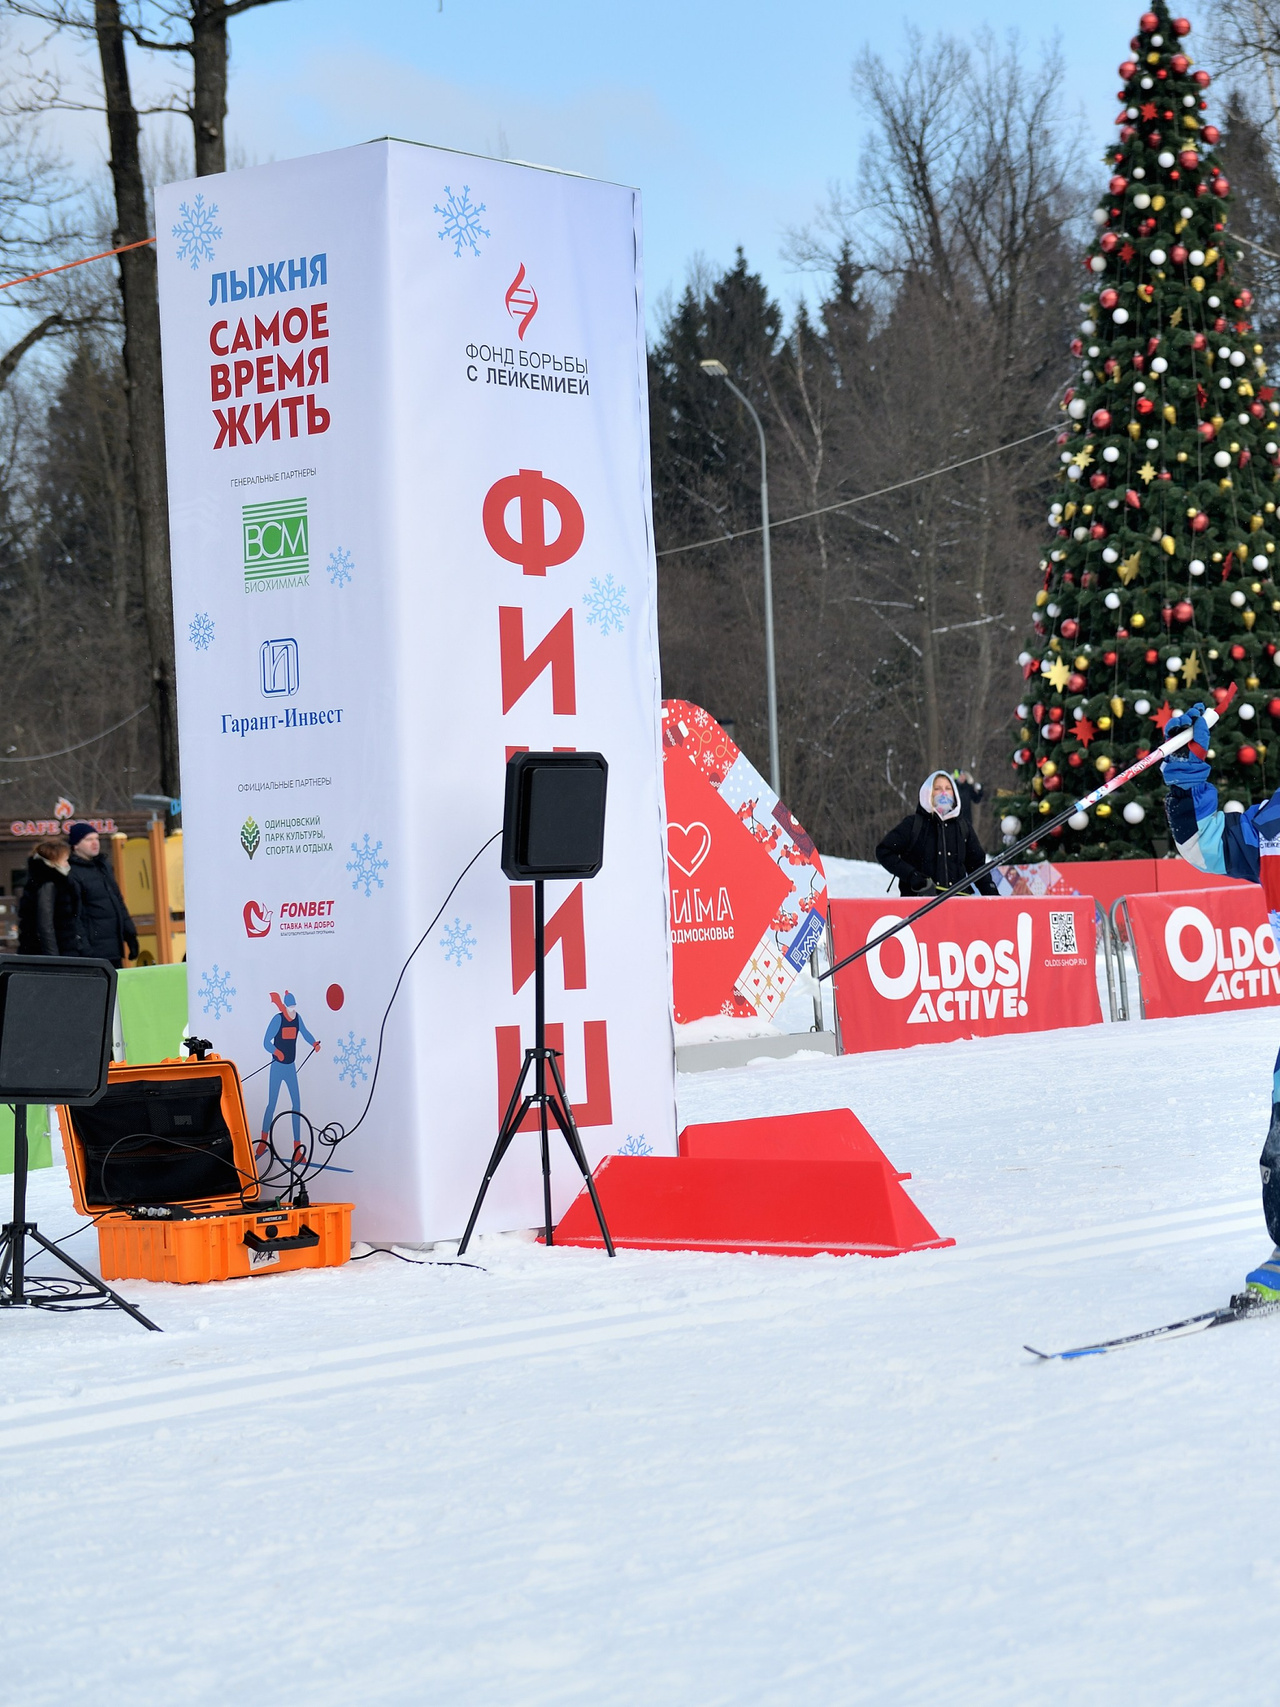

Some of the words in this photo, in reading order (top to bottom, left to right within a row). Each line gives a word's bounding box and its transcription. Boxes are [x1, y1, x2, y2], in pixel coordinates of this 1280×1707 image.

[208, 252, 328, 307] ЛЫЖНЯ
[209, 302, 330, 357] САМОЕ
[210, 345, 329, 403] ВРЕМЯ
[465, 343, 515, 367] ФОНД
[519, 350, 589, 375] БОРЬБЫ
[466, 364, 479, 383] С
[486, 366, 590, 396] ЛЕЙКЕМИЕЙ
[212, 393, 331, 450] ЖИТЬ
[230, 472, 280, 488] ГЕНЕРАЛЬНЫЕ
[280, 467, 317, 481] ПАРТНЕРЫ
[244, 575, 310, 594] БИОХИММАК
[220, 707, 344, 738] Гарант-Инвест
[237, 780, 294, 793] ОФИЦИАЛЬНЫЕ
[295, 777, 332, 788] ПАРТНЕРЫ
[482, 468, 613, 1135] ФИИШ
[10, 820, 61, 836] CAFE
[62, 818, 118, 834] GILL
[264, 815, 321, 830] ОДИНЦОВСКИЙ
[265, 832, 285, 842] ПАРК
[286, 830, 326, 841] КУЛЬТУРЫ,
[265, 845, 294, 856] СПОРТА
[295, 845, 301, 853] И
[302, 842, 333, 853] ОТДЫХА
[280, 900, 335, 918] FONBET
[672, 886, 734, 924] ИМА
[280, 922, 302, 931] СТАВКА
[314, 920, 335, 929] ДОБРО
[1164, 905, 1280, 982] OLDO
